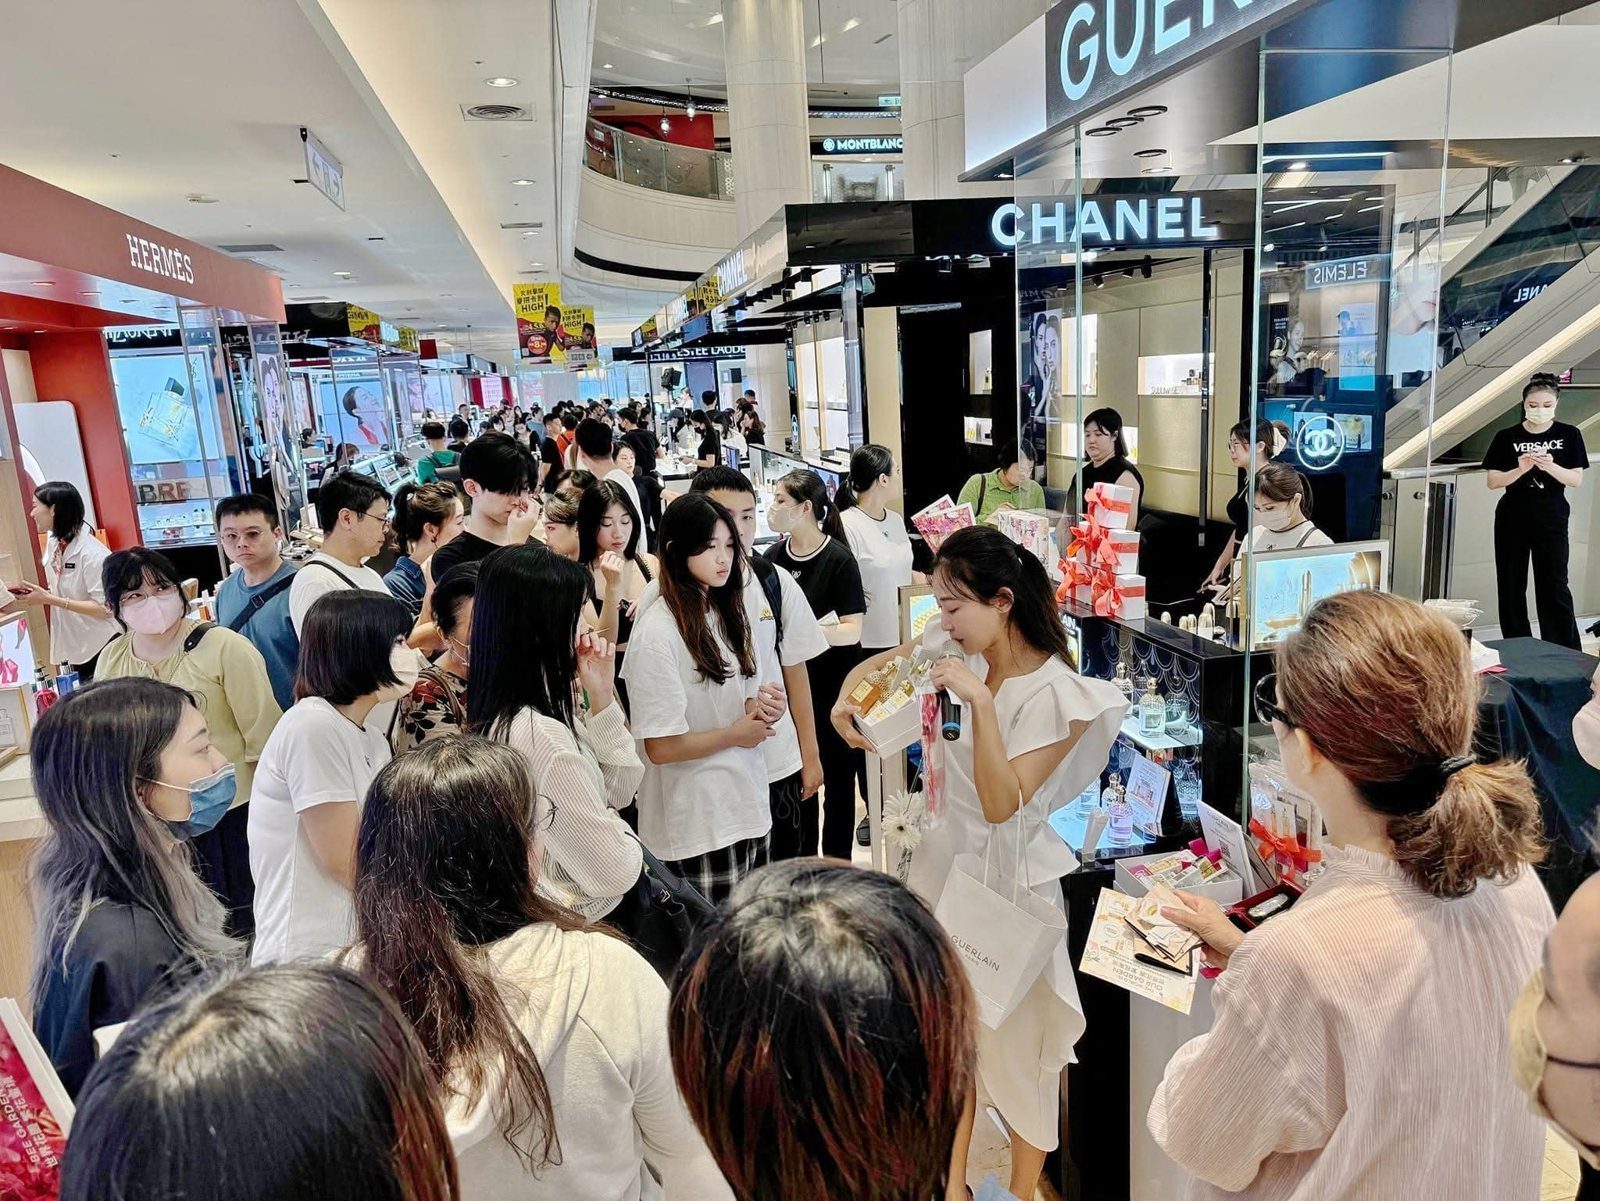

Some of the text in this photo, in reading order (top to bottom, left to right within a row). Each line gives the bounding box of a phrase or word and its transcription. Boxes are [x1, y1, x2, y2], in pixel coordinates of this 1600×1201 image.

[837, 138, 904, 150] MONTBLANC
[991, 197, 1218, 246] CHANEL
[1513, 439, 1564, 453] VERSACE
[951, 935, 1000, 971] GUERLAIN
